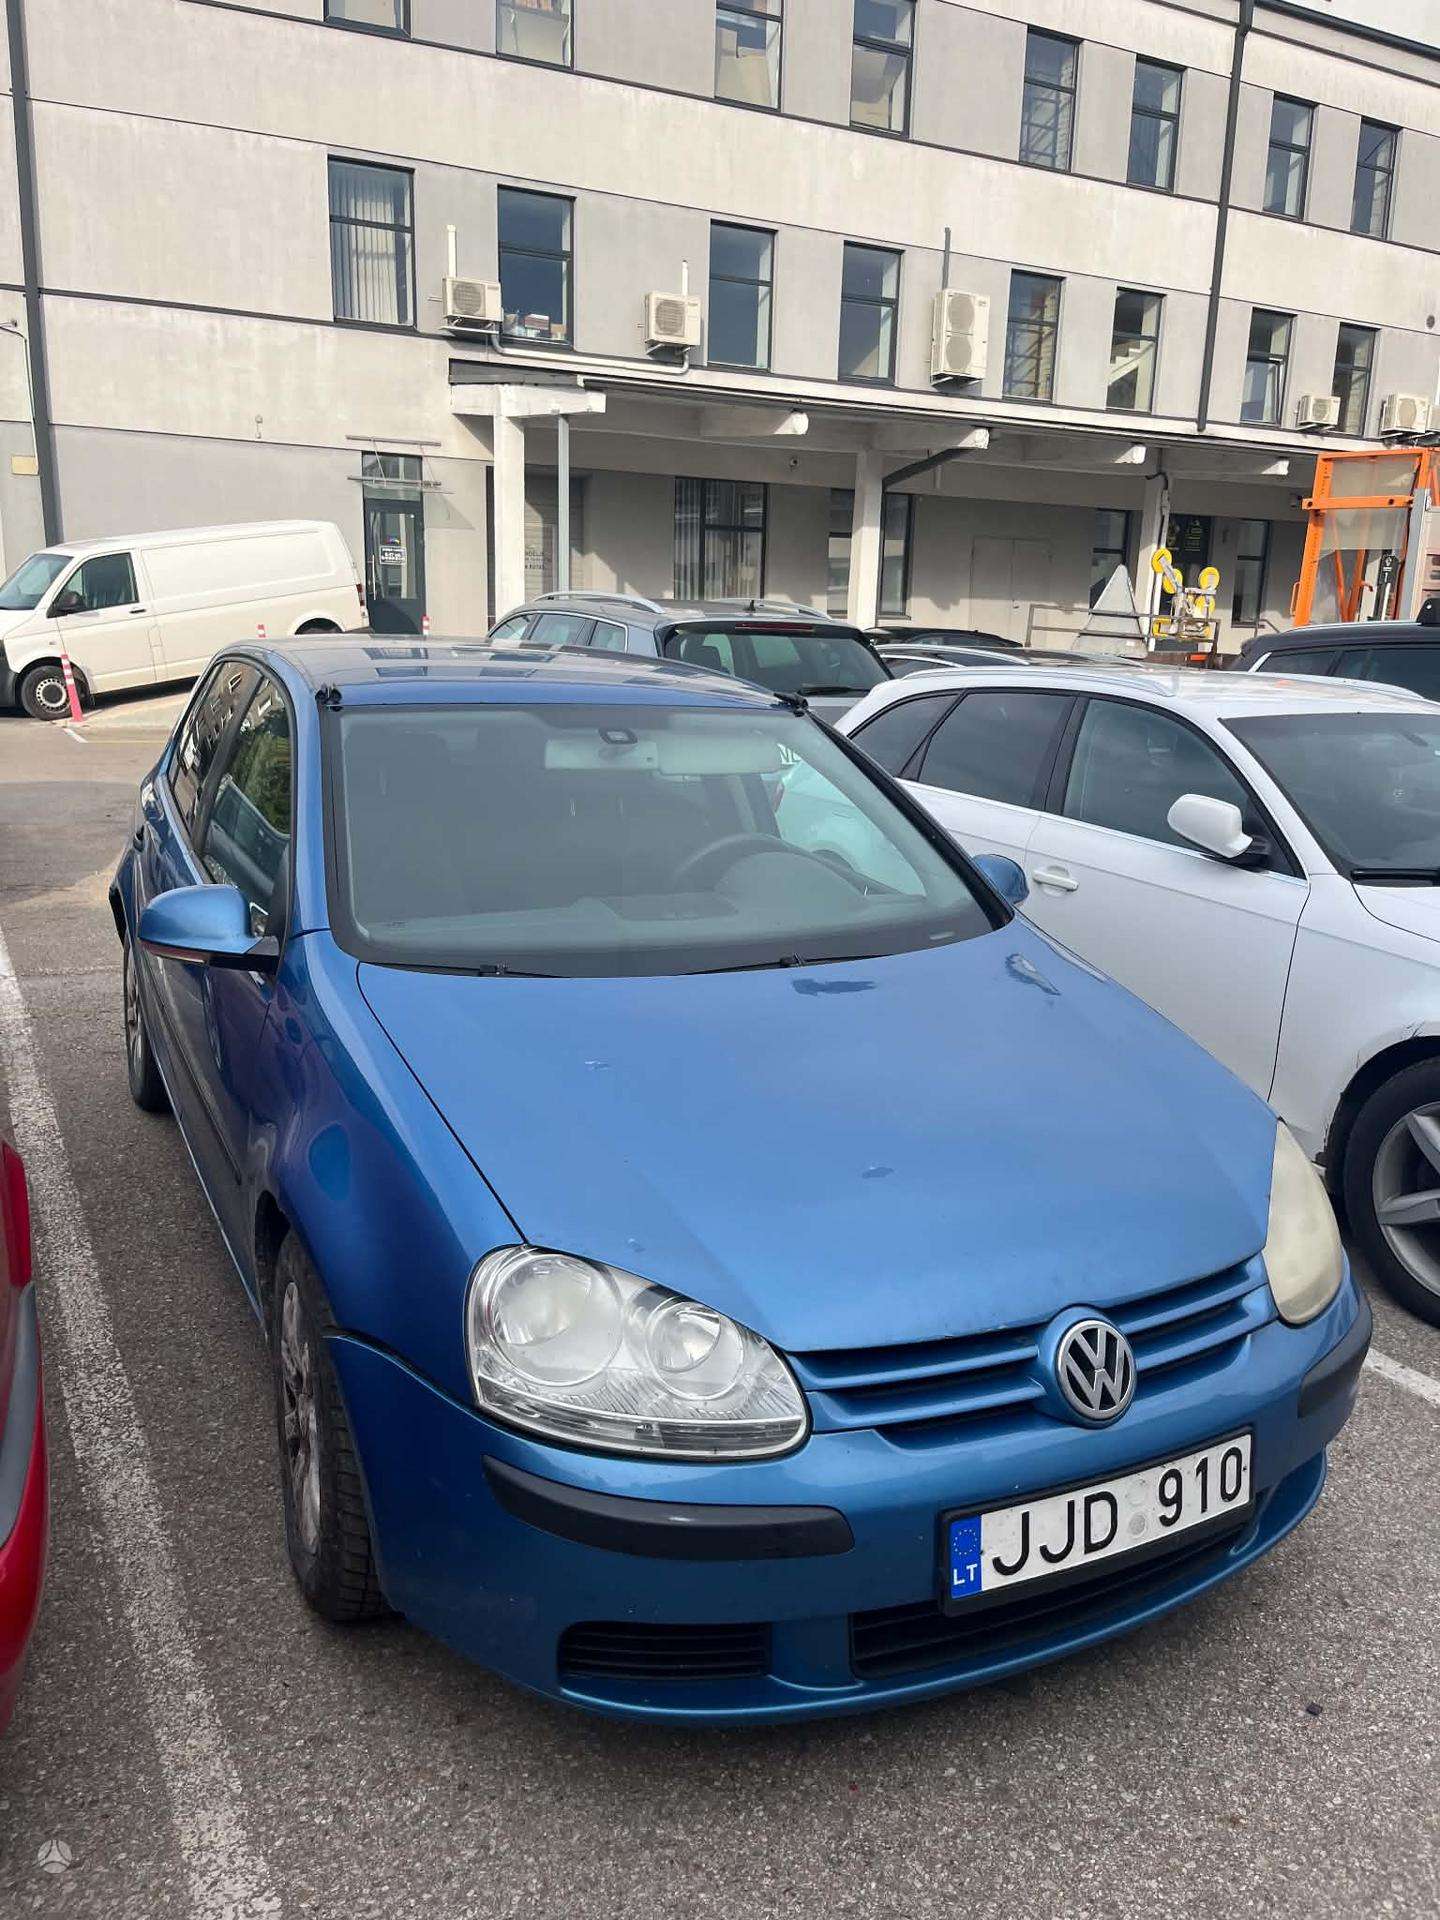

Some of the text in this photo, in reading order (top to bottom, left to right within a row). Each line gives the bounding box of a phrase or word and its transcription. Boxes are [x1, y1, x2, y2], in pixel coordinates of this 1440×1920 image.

[1060, 1322, 1132, 1416] VW
[991, 1446, 1243, 1576] JJD 910
[952, 1563, 978, 1586] LT
